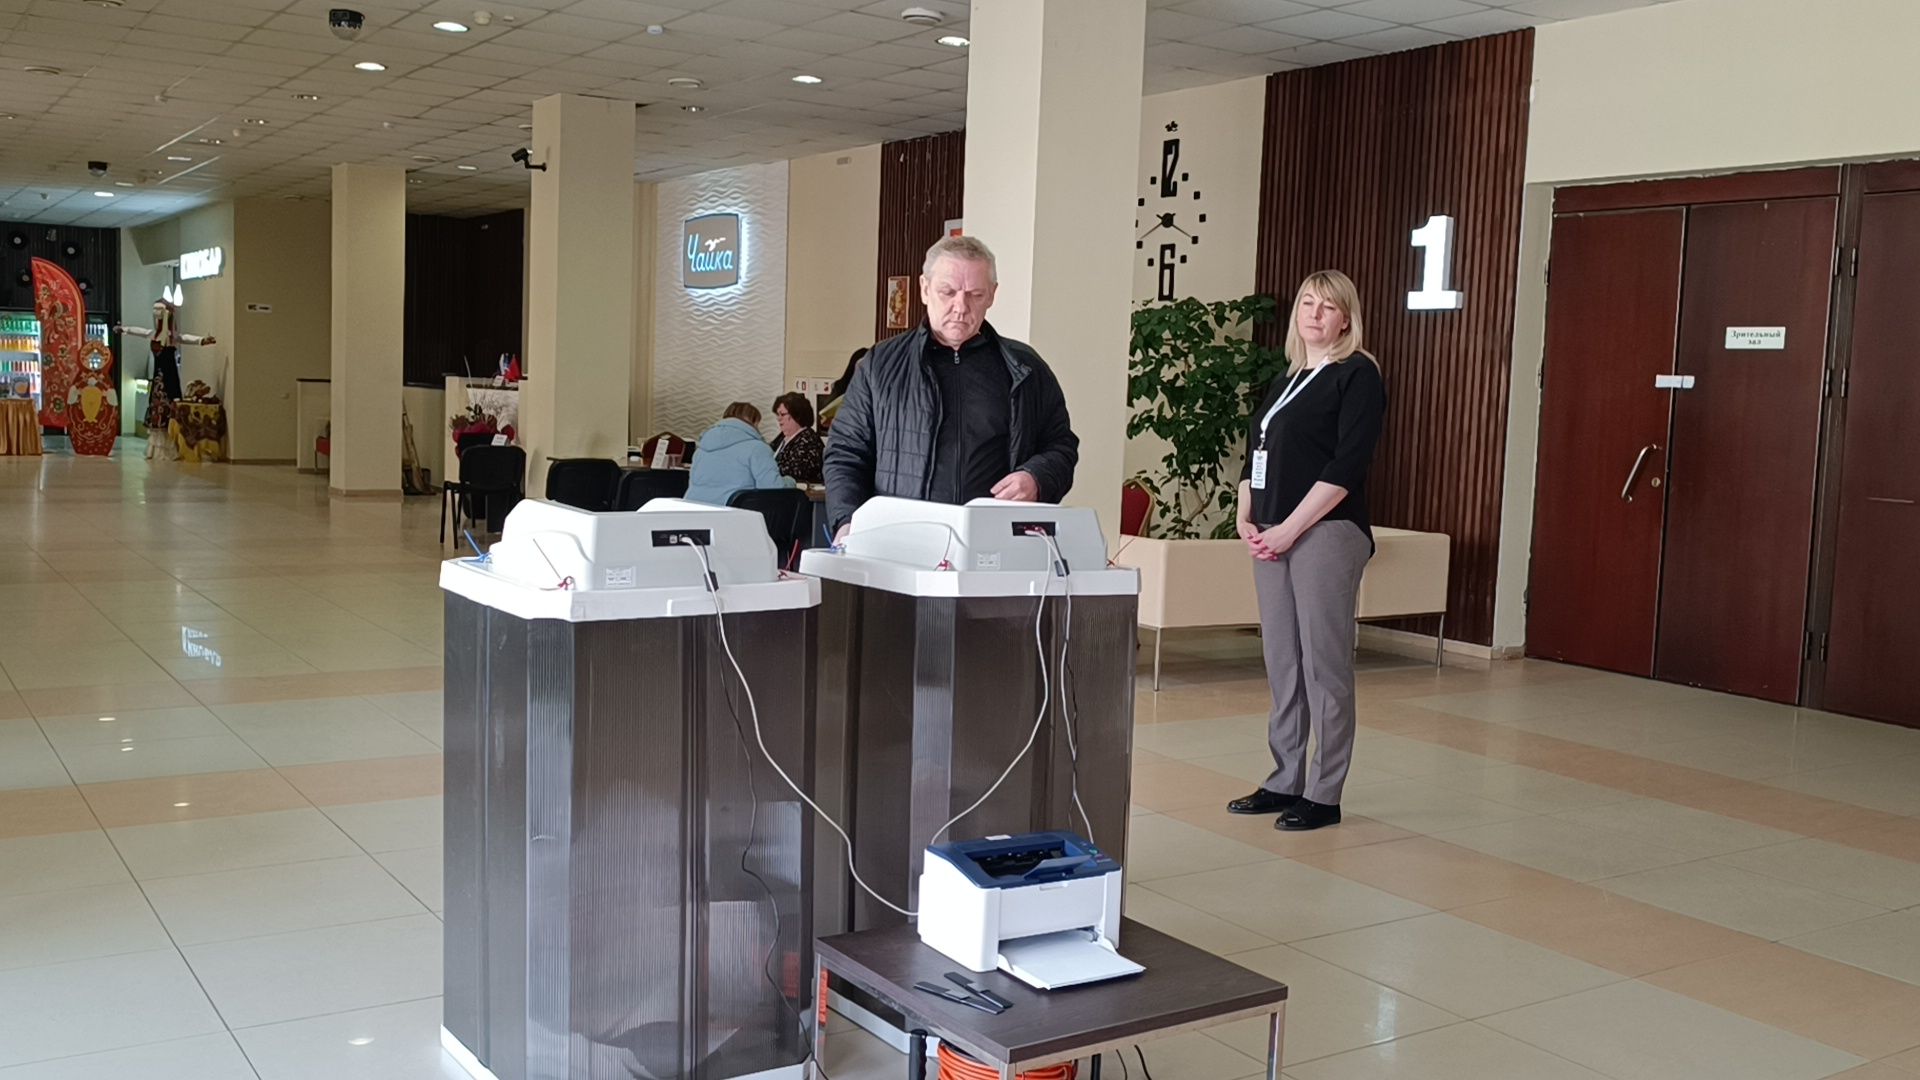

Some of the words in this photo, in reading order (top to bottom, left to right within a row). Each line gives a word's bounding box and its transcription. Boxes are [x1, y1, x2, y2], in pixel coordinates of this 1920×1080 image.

[687, 233, 733, 272] Чайка
[1158, 243, 1176, 301] 6
[1407, 215, 1460, 310] 1
[1731, 330, 1781, 339] Зрительный
